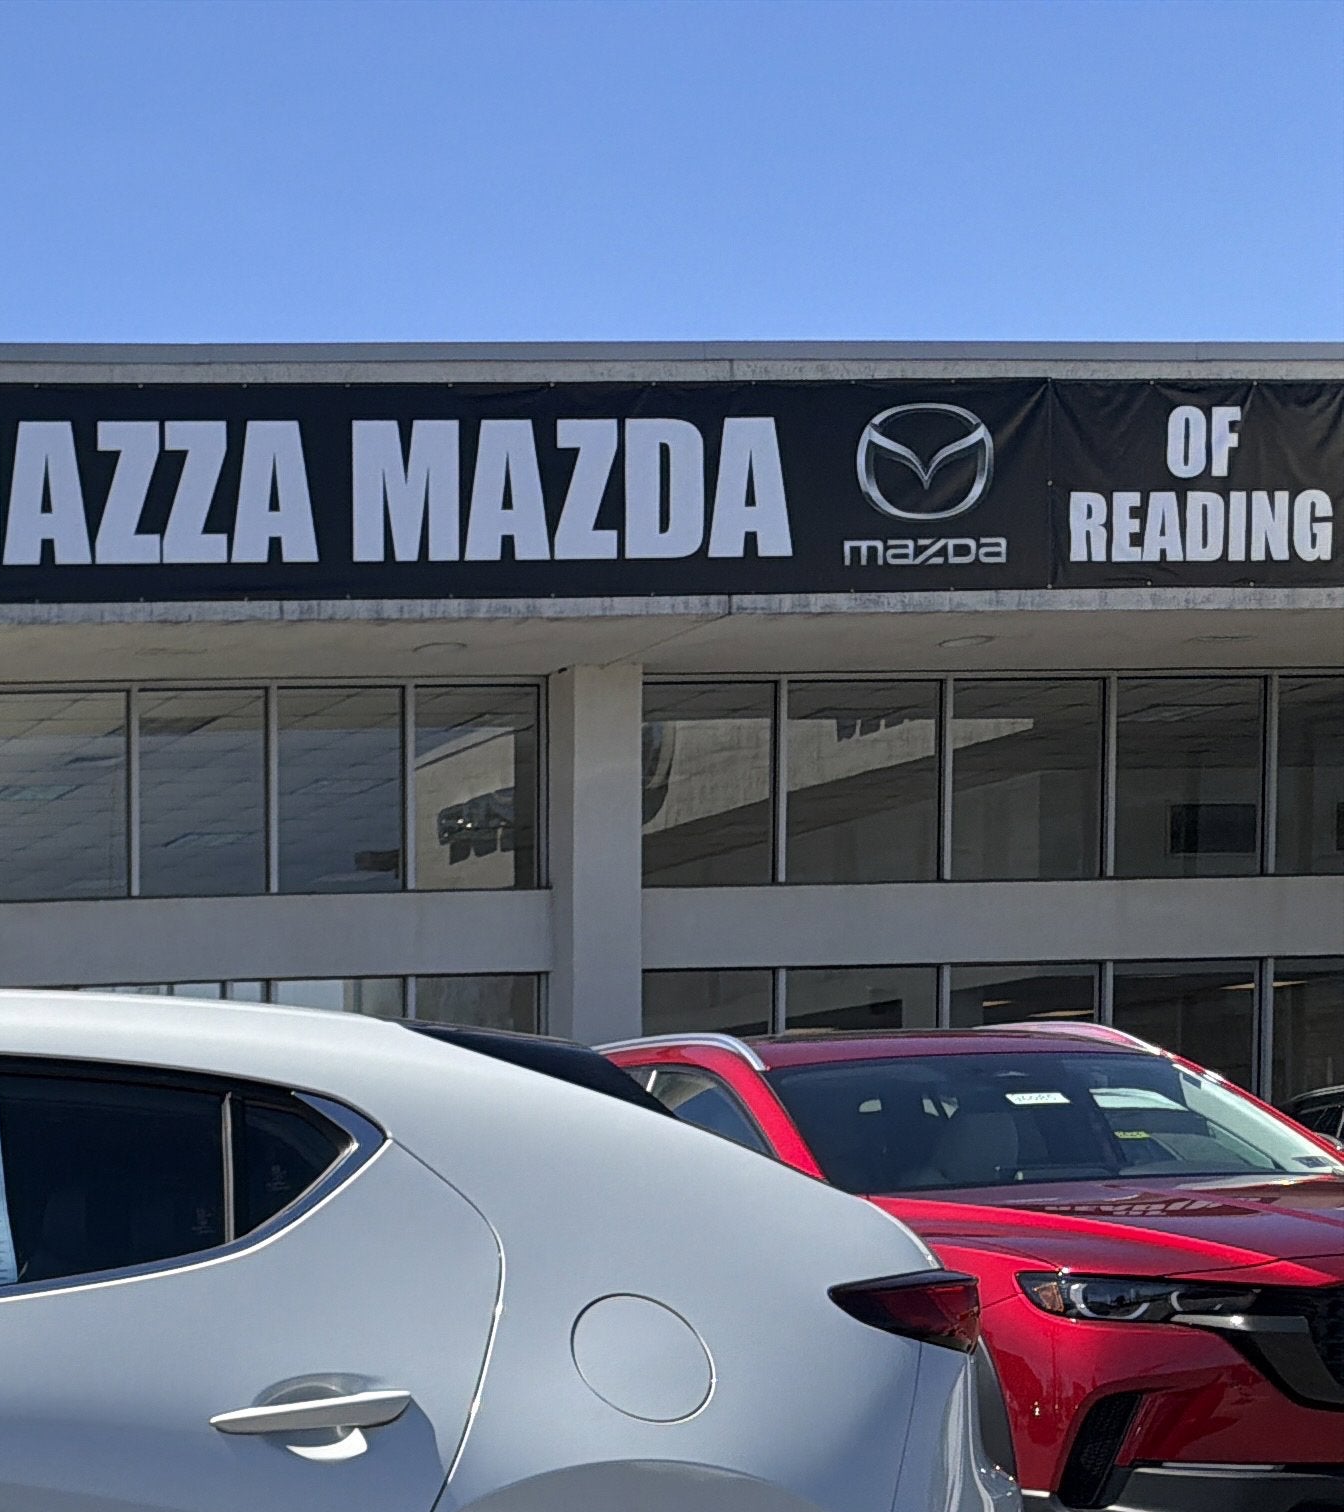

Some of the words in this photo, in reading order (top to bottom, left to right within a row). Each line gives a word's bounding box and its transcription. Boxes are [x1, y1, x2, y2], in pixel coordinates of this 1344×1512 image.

[1166, 405, 1242, 479] OF
[351, 416, 793, 563] MAZDA
[1069, 488, 1334, 563] READING
[843, 536, 1007, 566] mazda
